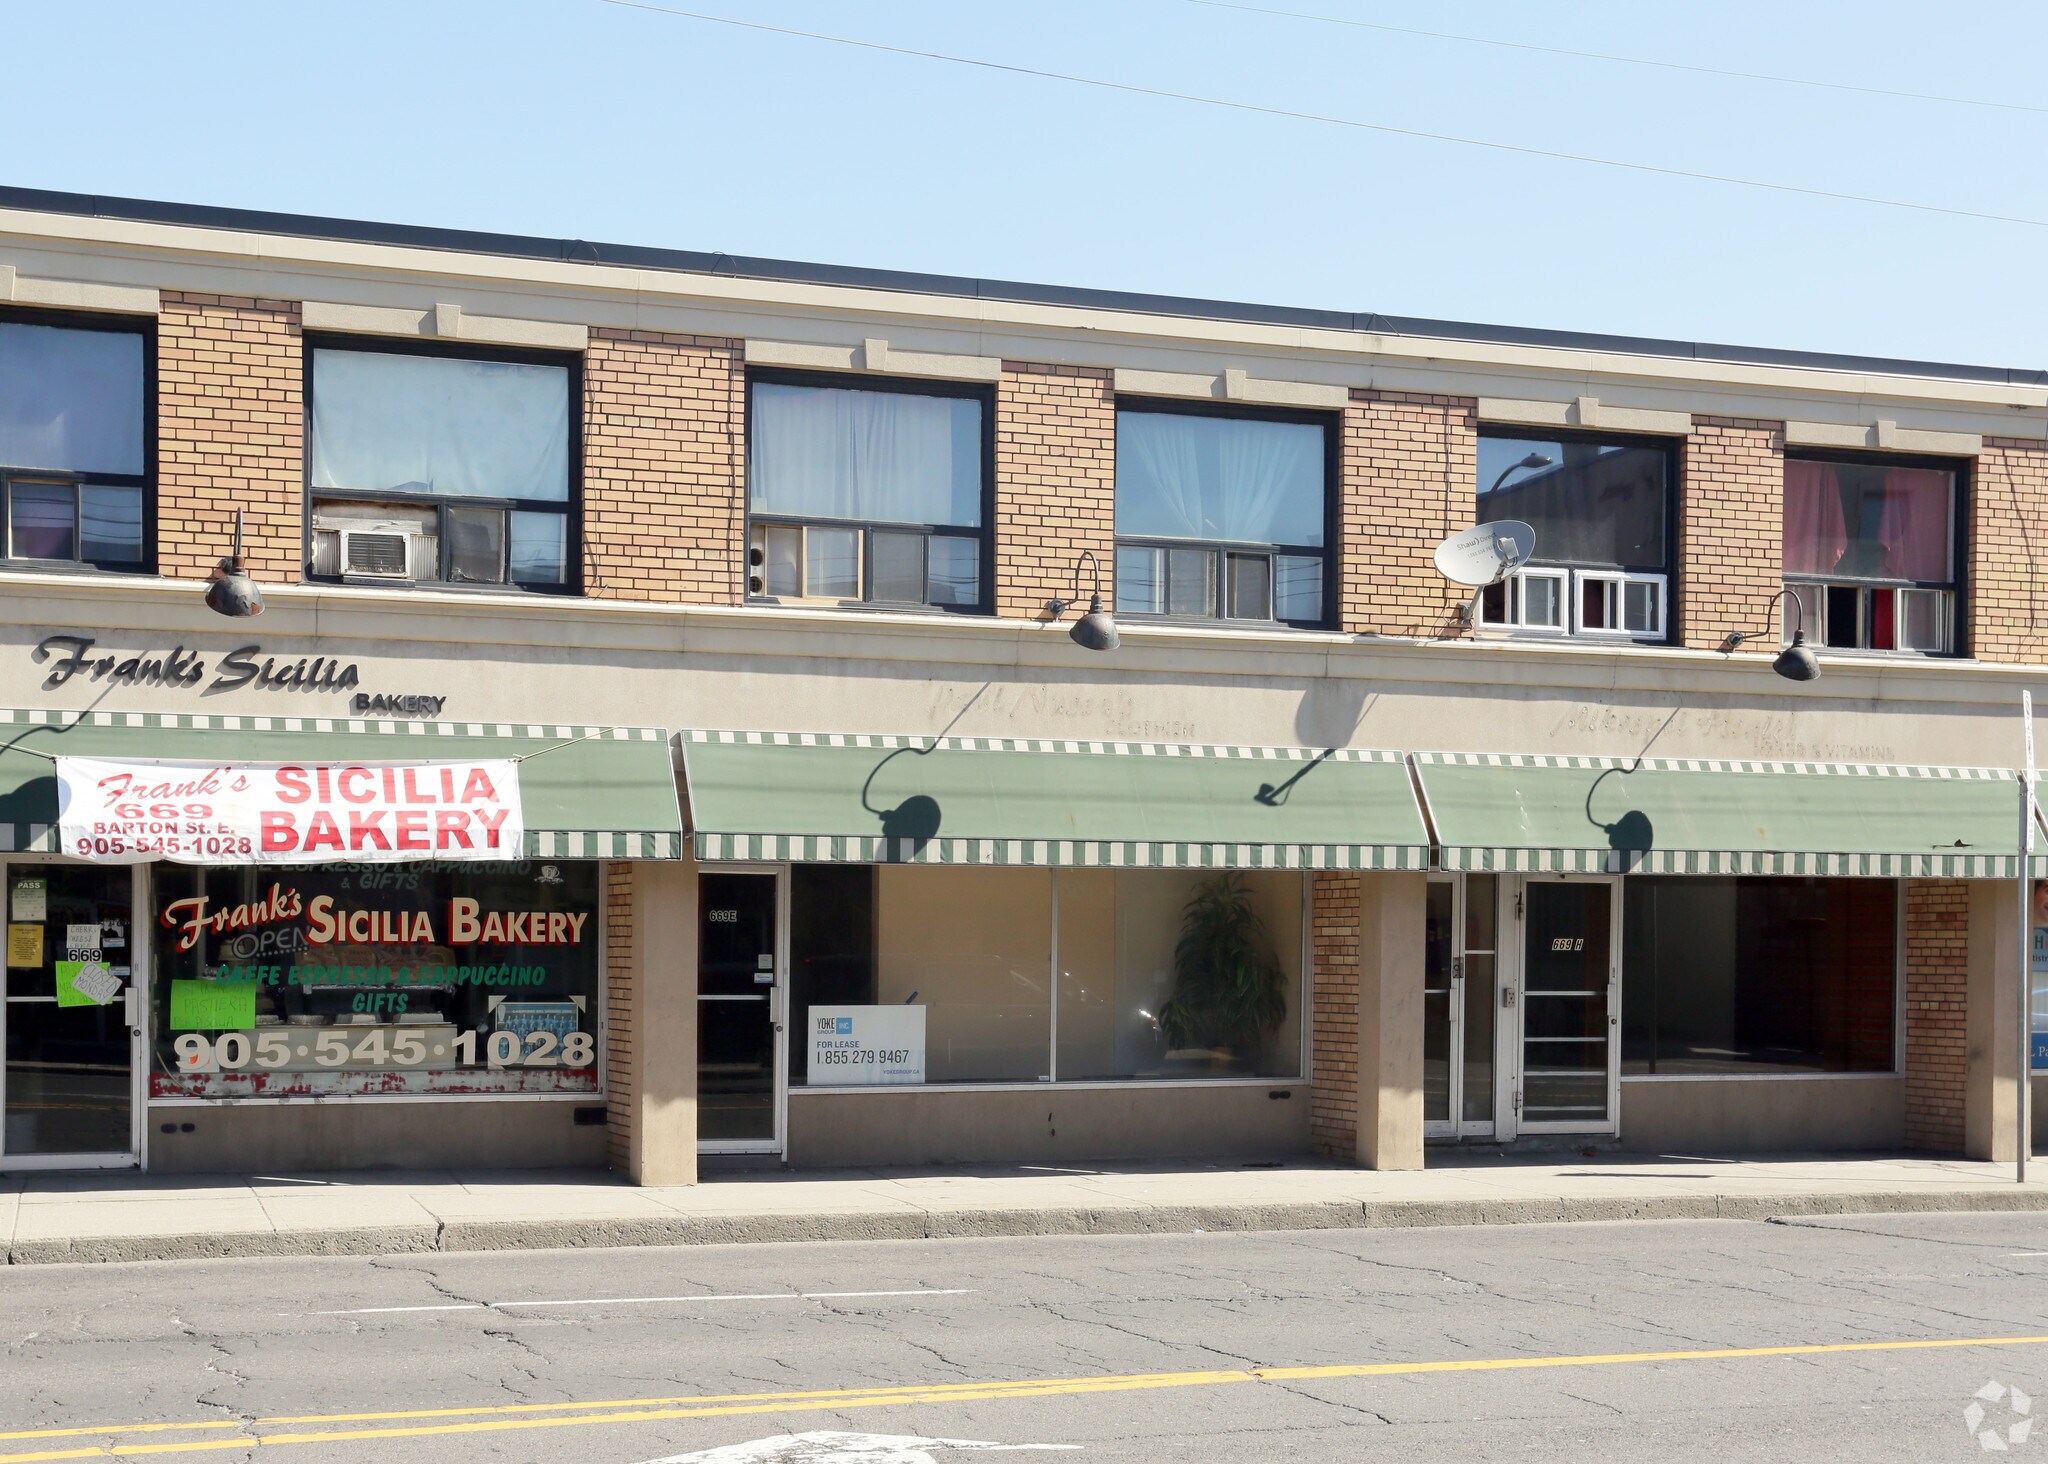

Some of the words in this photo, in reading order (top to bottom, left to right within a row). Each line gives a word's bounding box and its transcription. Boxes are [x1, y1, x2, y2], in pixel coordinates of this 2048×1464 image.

[38, 636, 204, 686] Frank's
[207, 645, 360, 689] Sicilia
[355, 692, 447, 714] BAKERY
[97, 766, 251, 808] Frank's
[275, 766, 500, 804] SICILIA
[114, 803, 213, 819] 669
[94, 822, 178, 834] BARTON
[185, 822, 211, 834] St.
[217, 822, 235, 834] E.
[260, 808, 511, 852] BAKERY
[77, 836, 252, 856] 905-545-1028
[359, 873, 419, 890] GIFTS
[161, 882, 302, 952] Frank's
[710, 910, 738, 922] 669E
[232, 926, 310, 959] OPEN
[1551, 938, 1573, 950] 669
[1574, 938, 1584, 951] H
[69, 949, 102, 961] 669
[83, 964, 117, 994] CLOSED
[216, 965, 281, 985] CAFFE
[287, 965, 391, 986] ESPRESSO
[398, 966, 411, 985] &
[417, 965, 546, 986] CAPPUCCINO
[351, 993, 409, 1013] GIFTS
[816, 1018, 835, 1030] YOKE
[817, 1041, 833, 1049] FOR
